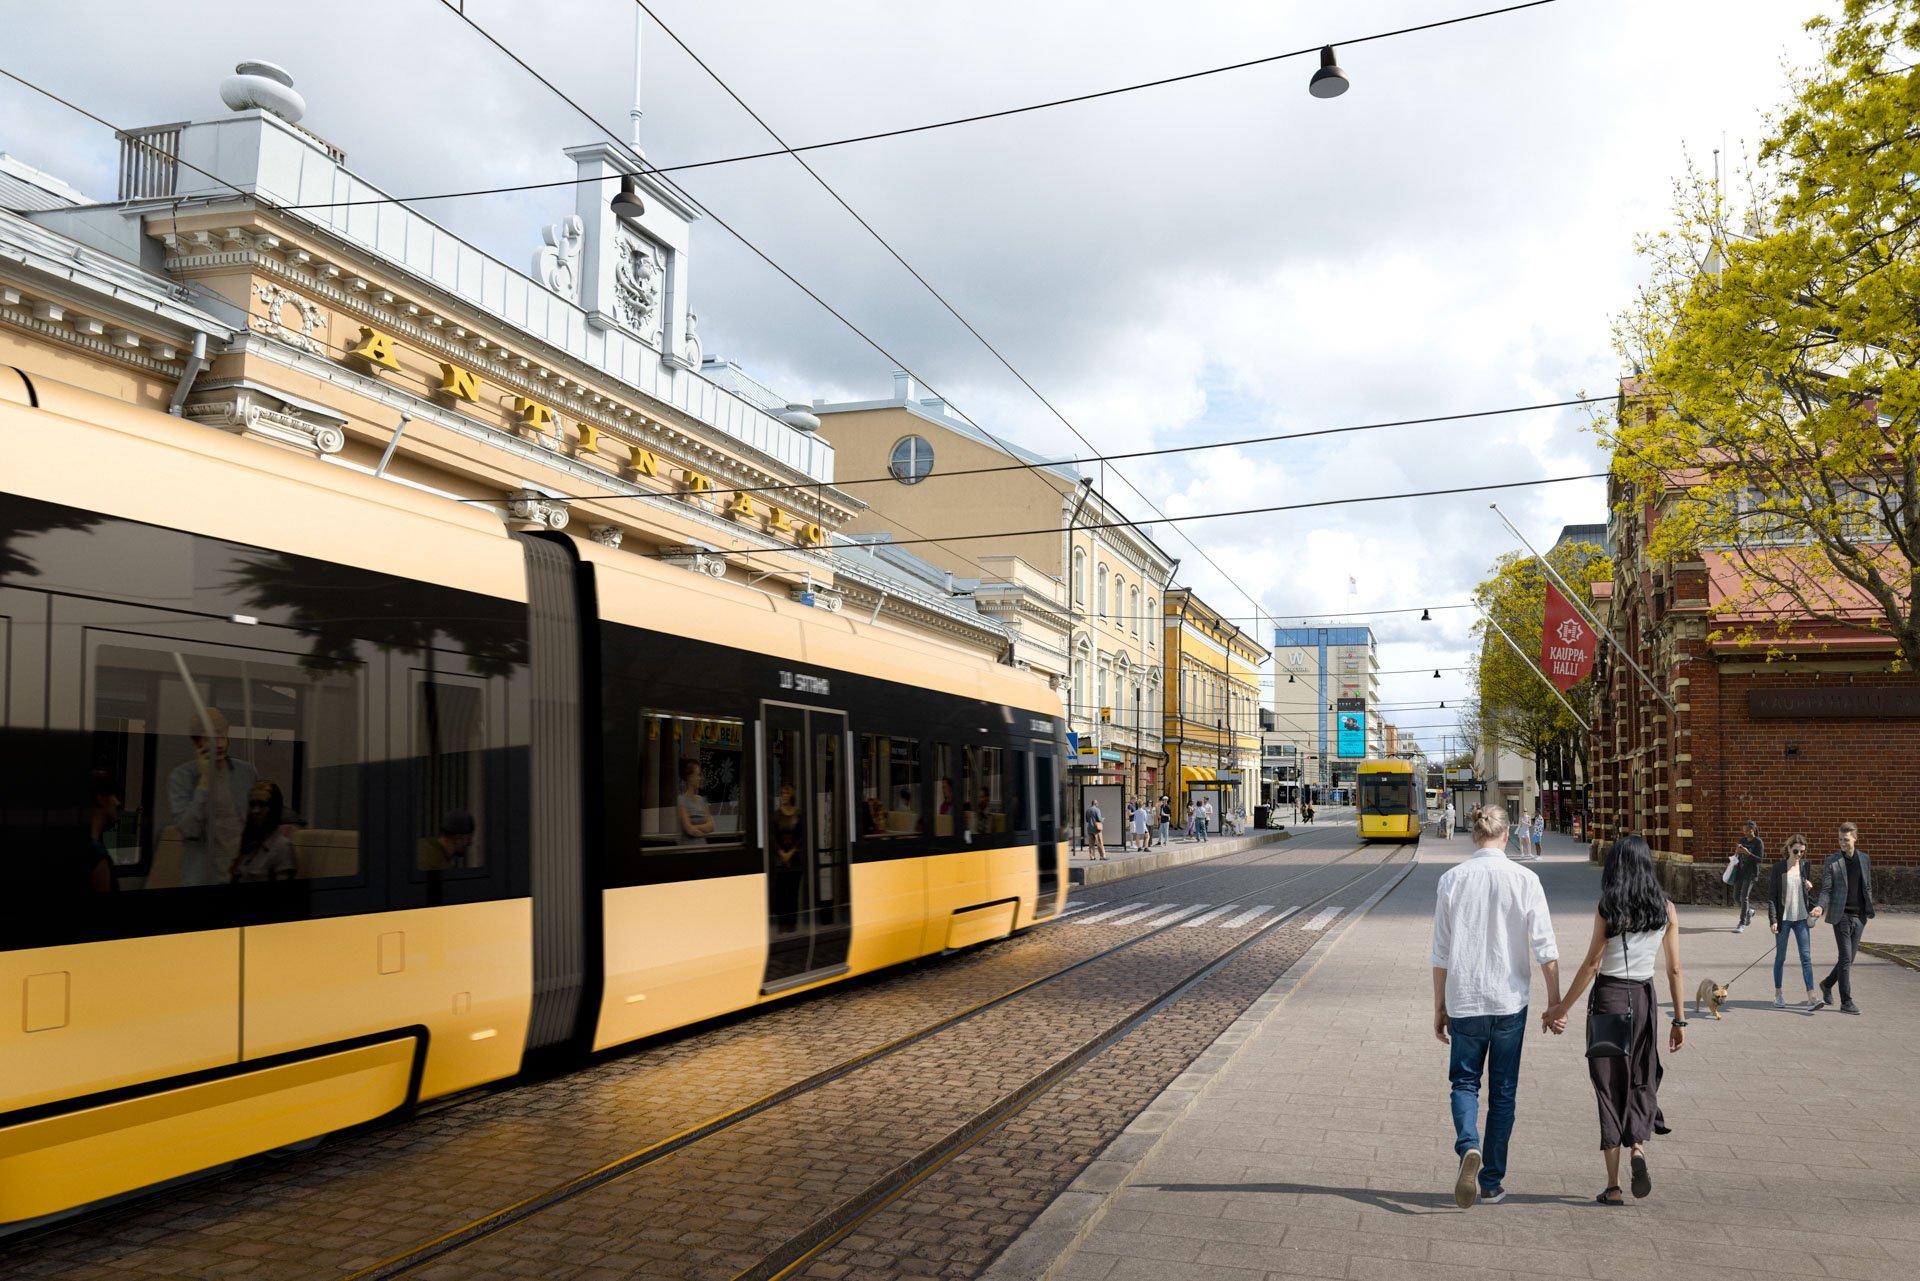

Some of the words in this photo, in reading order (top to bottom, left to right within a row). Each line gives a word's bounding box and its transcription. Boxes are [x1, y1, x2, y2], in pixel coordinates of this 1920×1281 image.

[349, 326, 821, 543] ANTINTALO
[1550, 647, 1588, 662] KAUPPA-
[1553, 661, 1578, 676] HALLI
